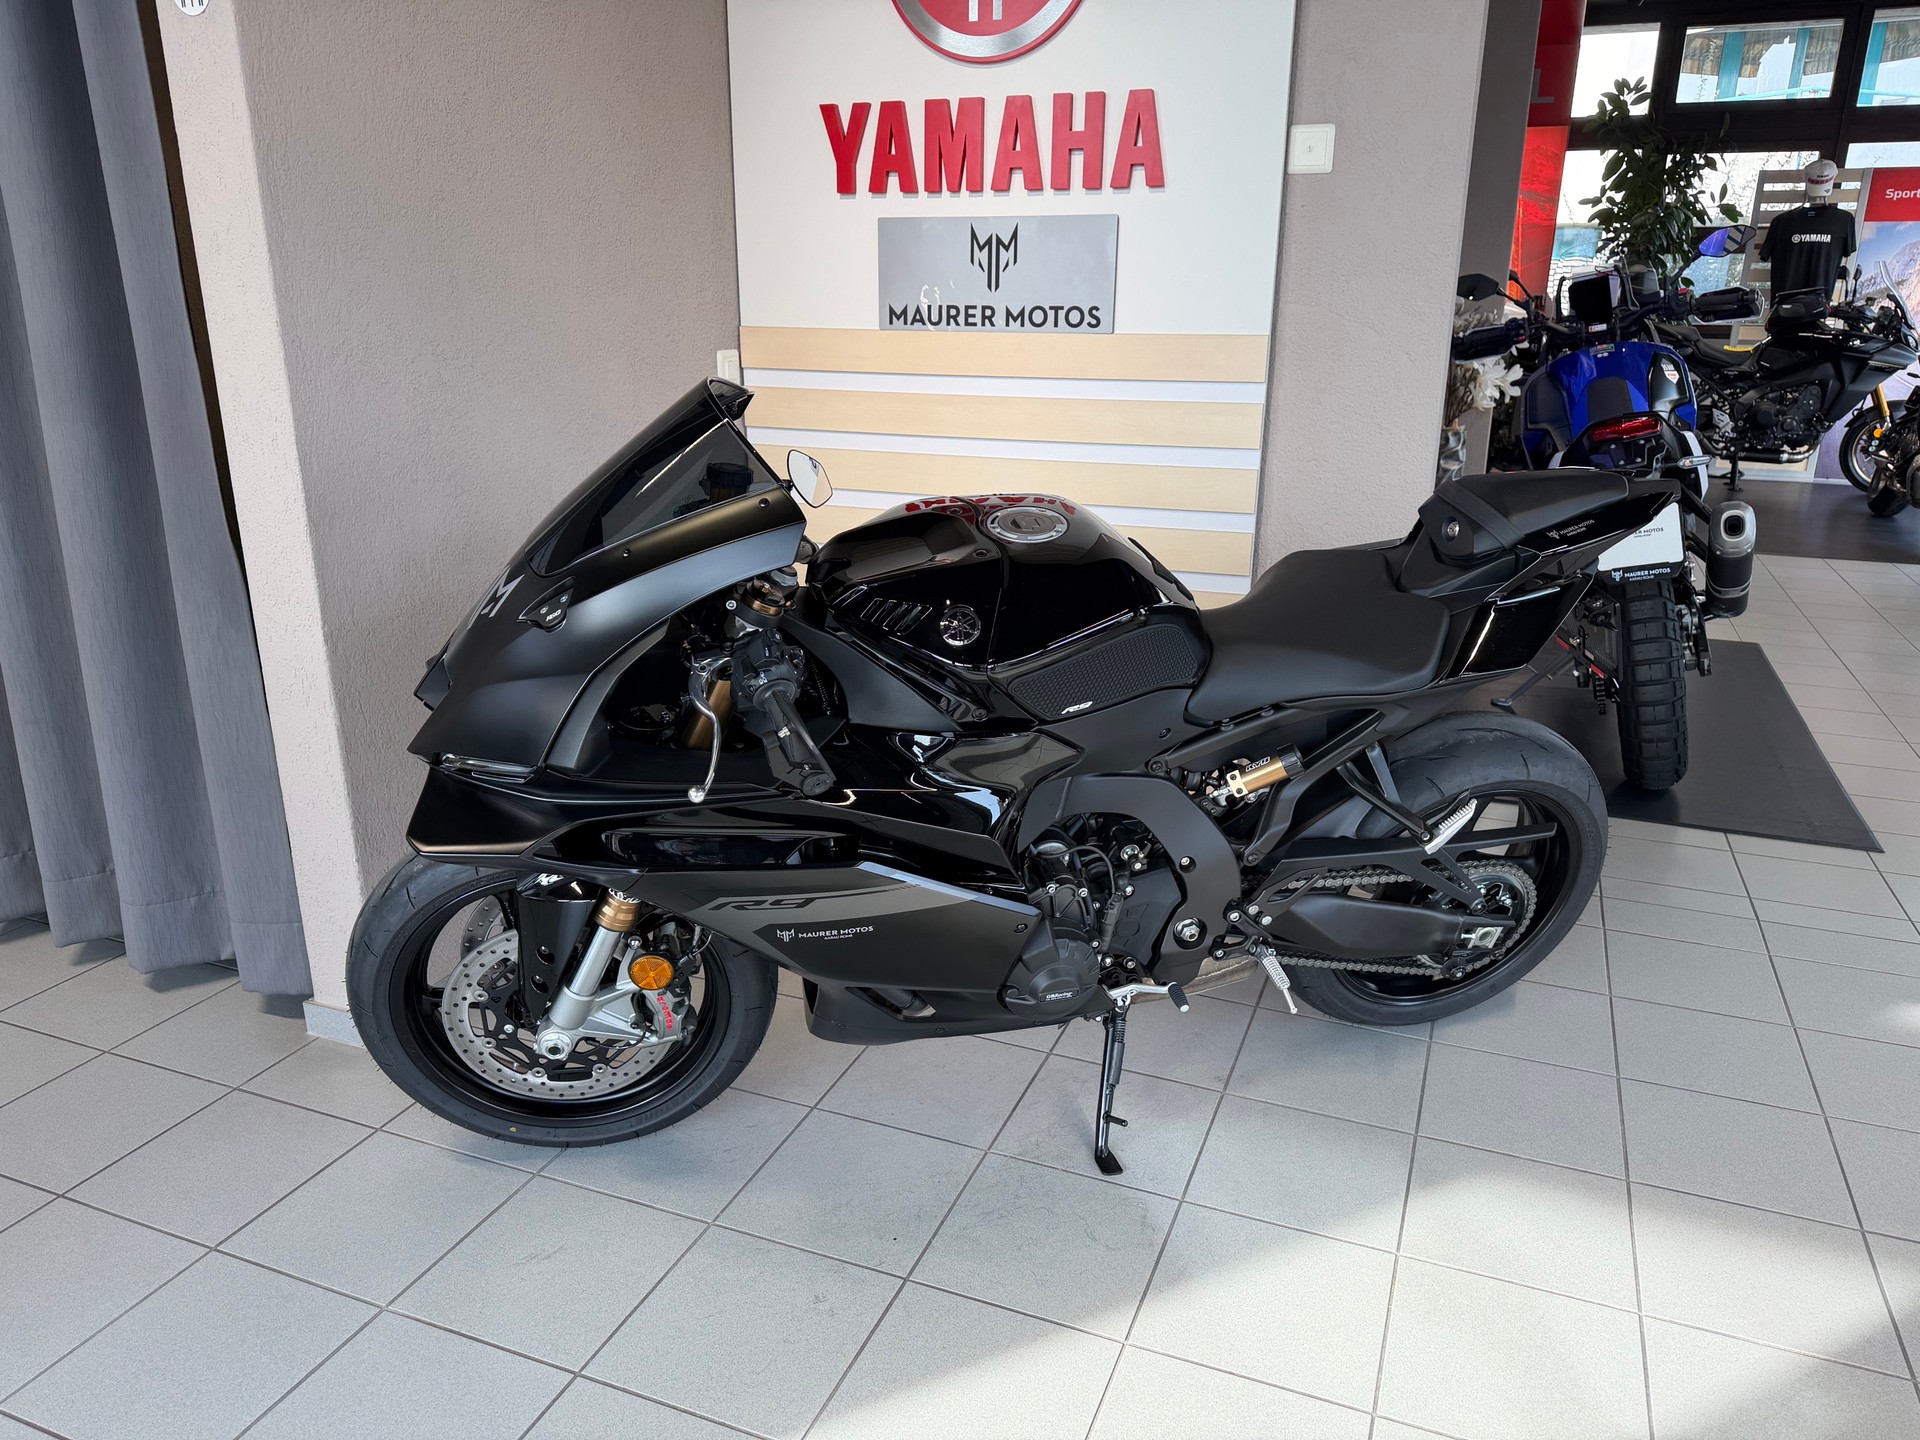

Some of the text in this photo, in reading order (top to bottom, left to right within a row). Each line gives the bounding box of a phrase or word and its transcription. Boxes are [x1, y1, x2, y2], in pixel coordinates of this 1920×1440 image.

[819, 88, 1166, 194] YAMAHA
[1800, 233, 1832, 243] YAMAHA
[888, 303, 1101, 329] MAURER MOTOS
[1624, 570, 1649, 578] MAURER
[1649, 567, 1671, 575] MOTOS
[798, 929, 838, 939] MAURER
[840, 925, 874, 935] MOTOS
